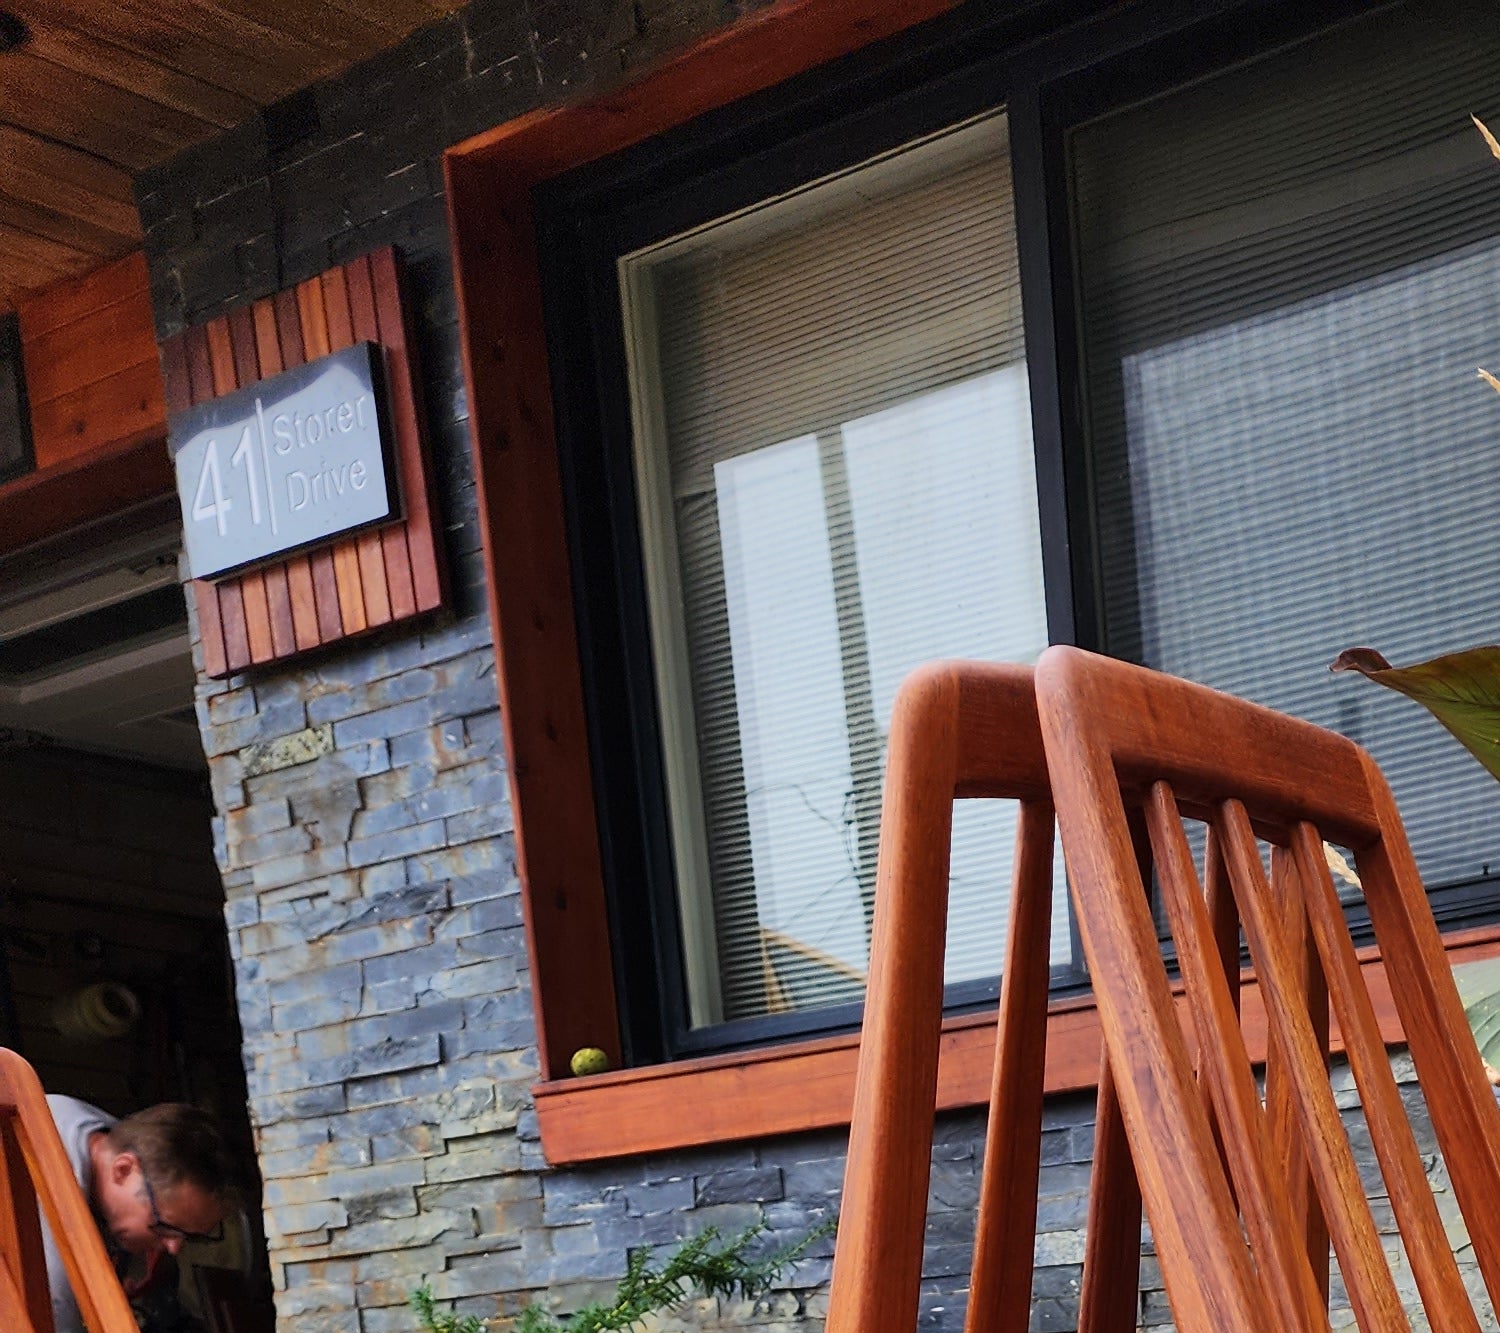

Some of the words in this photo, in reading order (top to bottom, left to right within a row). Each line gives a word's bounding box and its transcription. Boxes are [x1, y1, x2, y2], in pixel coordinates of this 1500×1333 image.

[273, 395, 367, 456] Storer
[191, 426, 260, 537] 41
[286, 458, 367, 512] Drive
